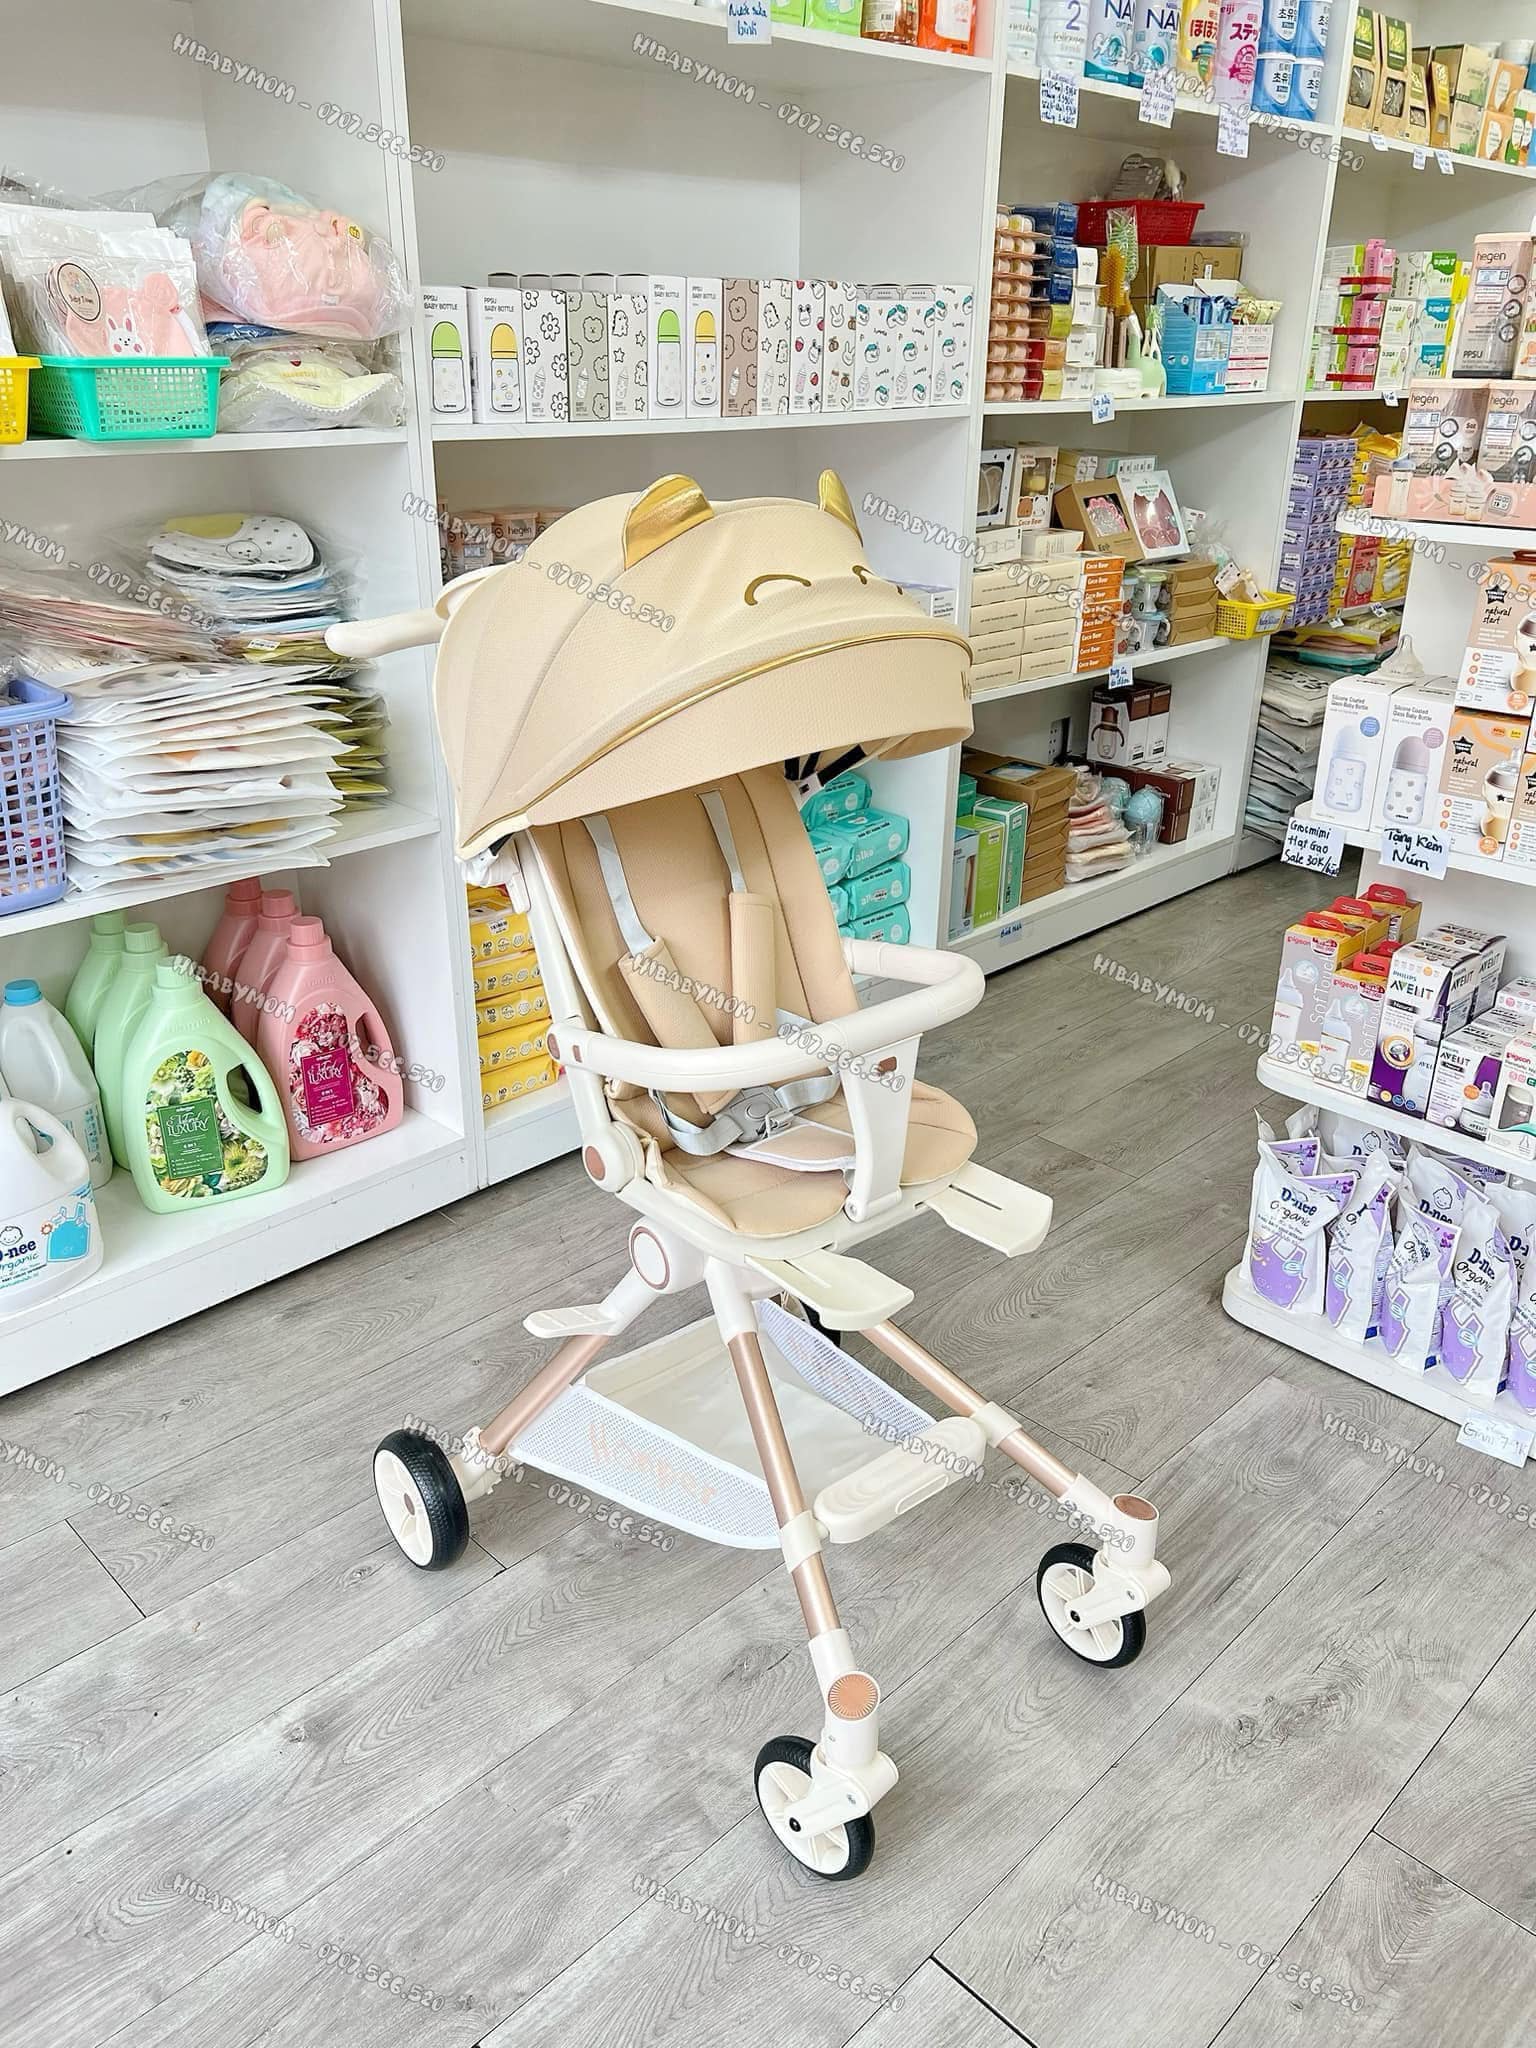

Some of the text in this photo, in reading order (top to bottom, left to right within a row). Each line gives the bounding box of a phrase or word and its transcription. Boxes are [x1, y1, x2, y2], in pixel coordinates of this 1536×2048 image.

[1065, 0, 1081, 30] 2
[1220, 5, 1235, 15] eiji
[1477, 251, 1506, 264] hegen
[1463, 350, 1483, 359] PPSU
[1411, 393, 1439, 407] hegen
[1490, 394, 1519, 408] hegen
[507, 524, 532, 537] hegen
[1484, 606, 1512, 617] natural
[1482, 615, 1501, 625] start
[1453, 756, 1479, 768] natural
[1451, 765, 1469, 775] start
[1384, 828, 1412, 851] Tặng
[1285, 849, 1304, 864] Sale
[1392, 849, 1430, 871] Núm
[1287, 935, 1311, 947] pigeon
[1393, 970, 1417, 982] PHILIPS
[1333, 978, 1359, 990] pigeon
[1390, 980, 1434, 1001] AVENT
[1440, 1052, 1472, 1067] AVENT
[1505, 1052, 1532, 1065] pigeon
[308, 1063, 344, 1084] LUXURY
[167, 1115, 210, 1137] LUXURY
[1281, 1187, 1317, 1216] D-nee
[1270, 1200, 1310, 1228] Organic
